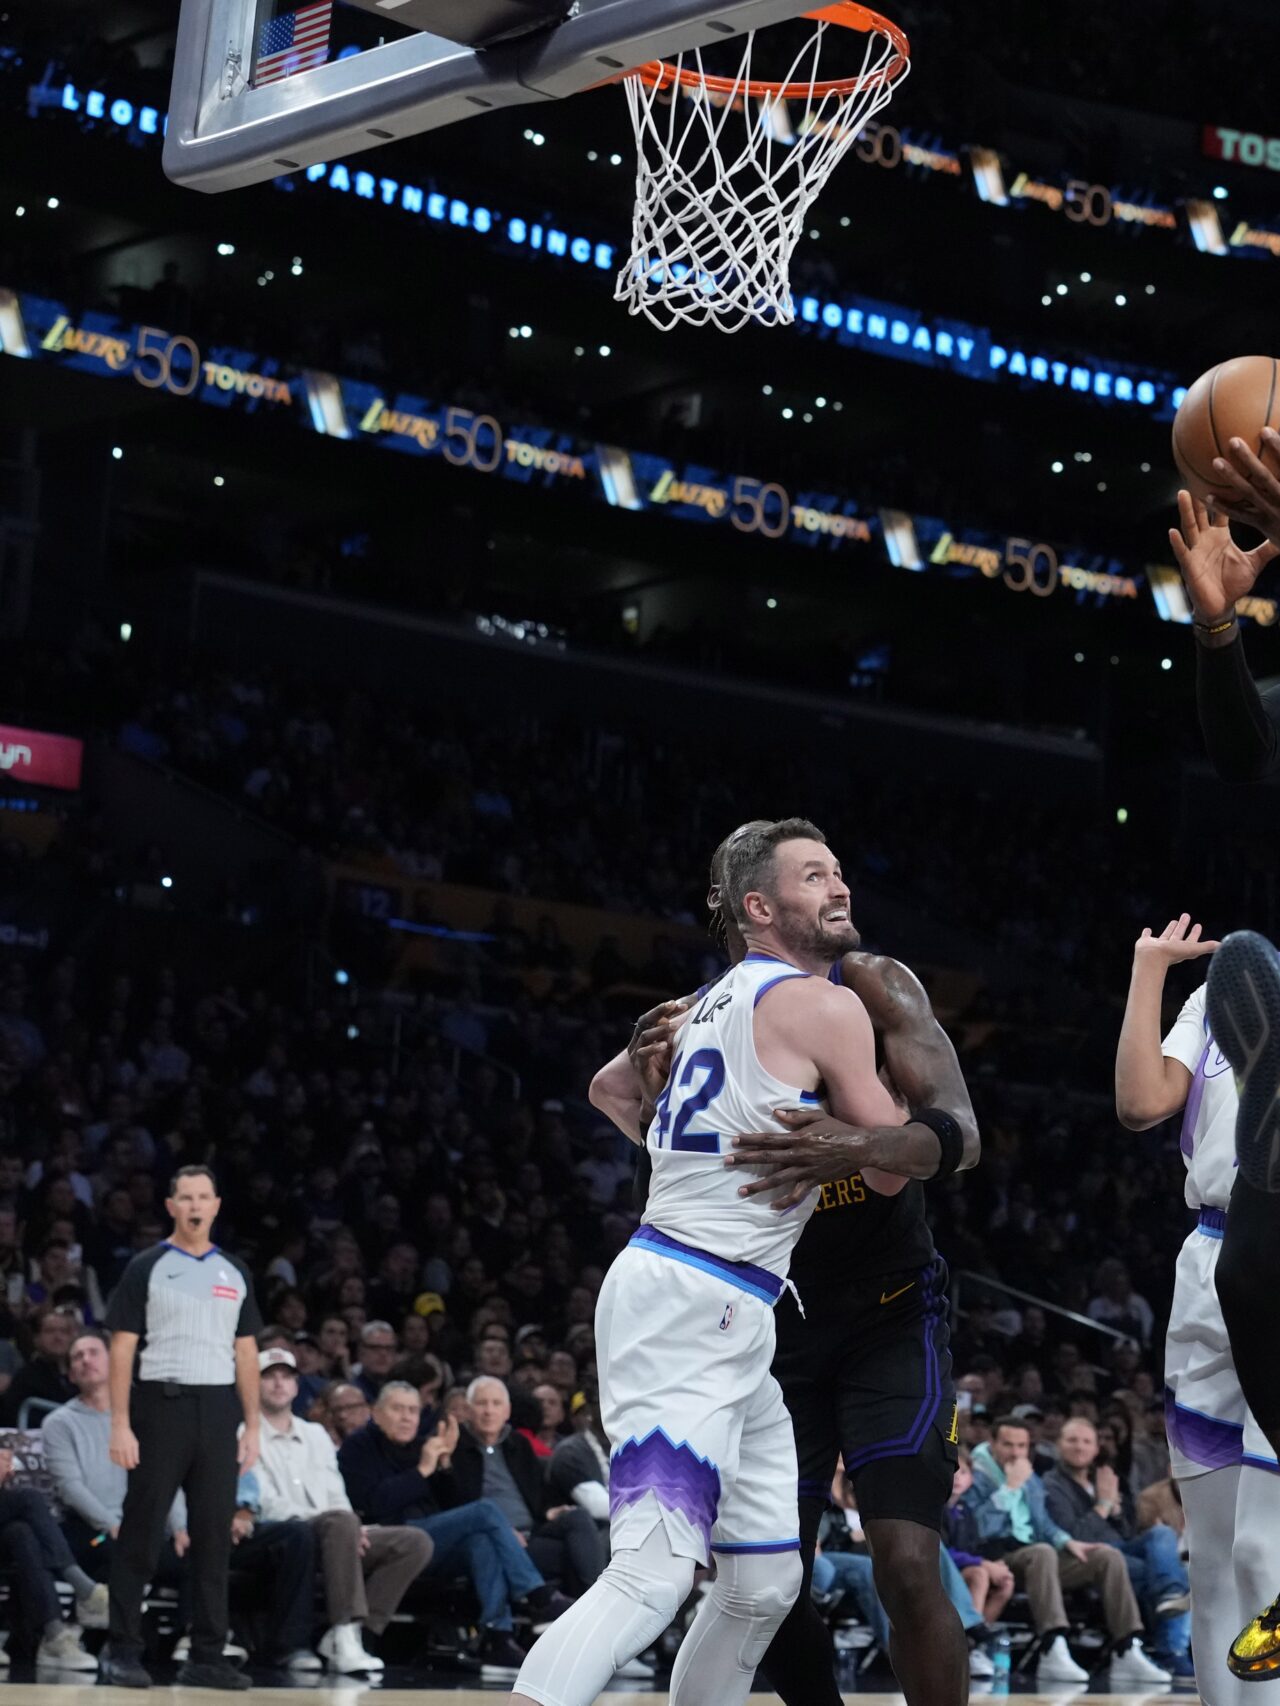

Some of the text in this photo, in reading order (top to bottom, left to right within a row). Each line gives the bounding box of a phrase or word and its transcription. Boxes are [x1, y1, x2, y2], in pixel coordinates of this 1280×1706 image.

[306, 162, 491, 233] PARTNERS
[508, 217, 613, 270] SINCE
[133, 325, 200, 396] 50
[202, 361, 293, 405] TOYOTA
[989, 345, 1155, 405] PARTNERS
[442, 406, 503, 473] 50
[503, 439, 586, 480] TOYOTA
[731, 475, 790, 539] 50
[1002, 538, 1059, 597] 50
[654, 1047, 726, 1153] 42
